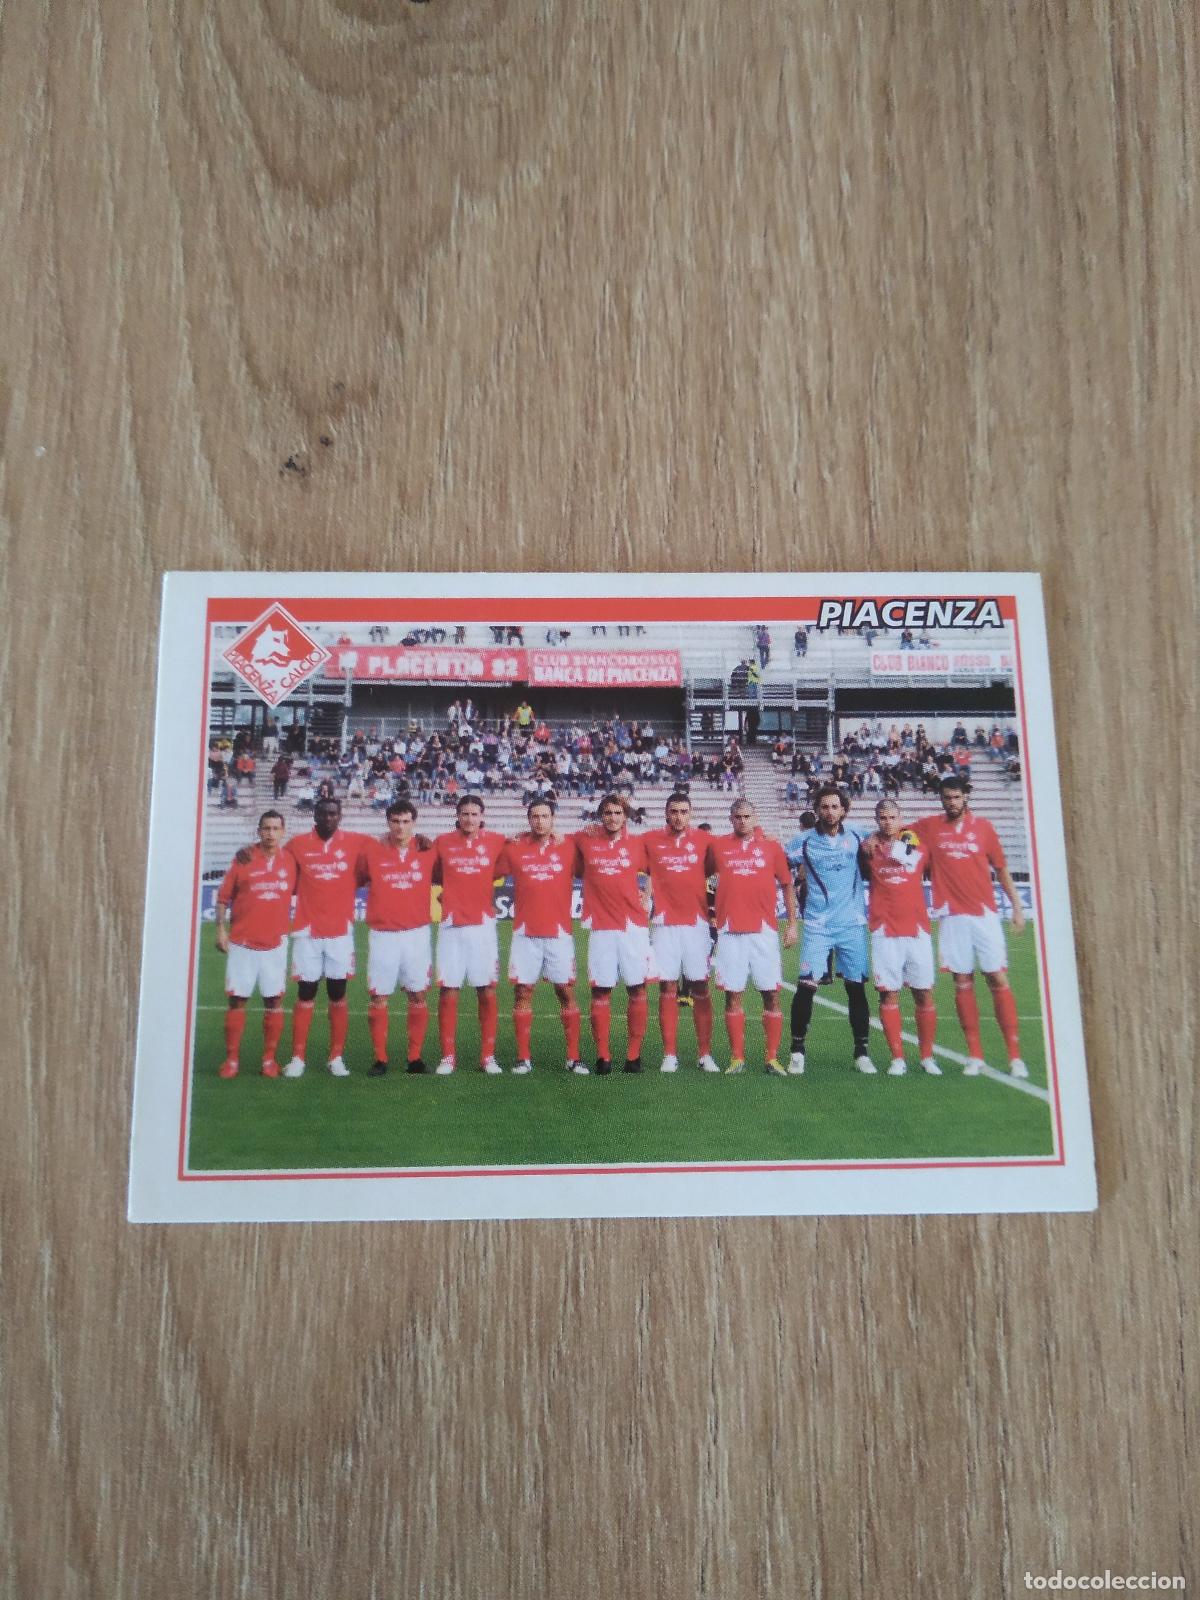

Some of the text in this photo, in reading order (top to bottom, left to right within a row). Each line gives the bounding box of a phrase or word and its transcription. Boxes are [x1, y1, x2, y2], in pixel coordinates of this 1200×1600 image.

[817, 599, 1005, 629] PIACENZA
[227, 650, 324, 701] PIACENZA CALCIO
[907, 654, 949, 672] BIANCO
